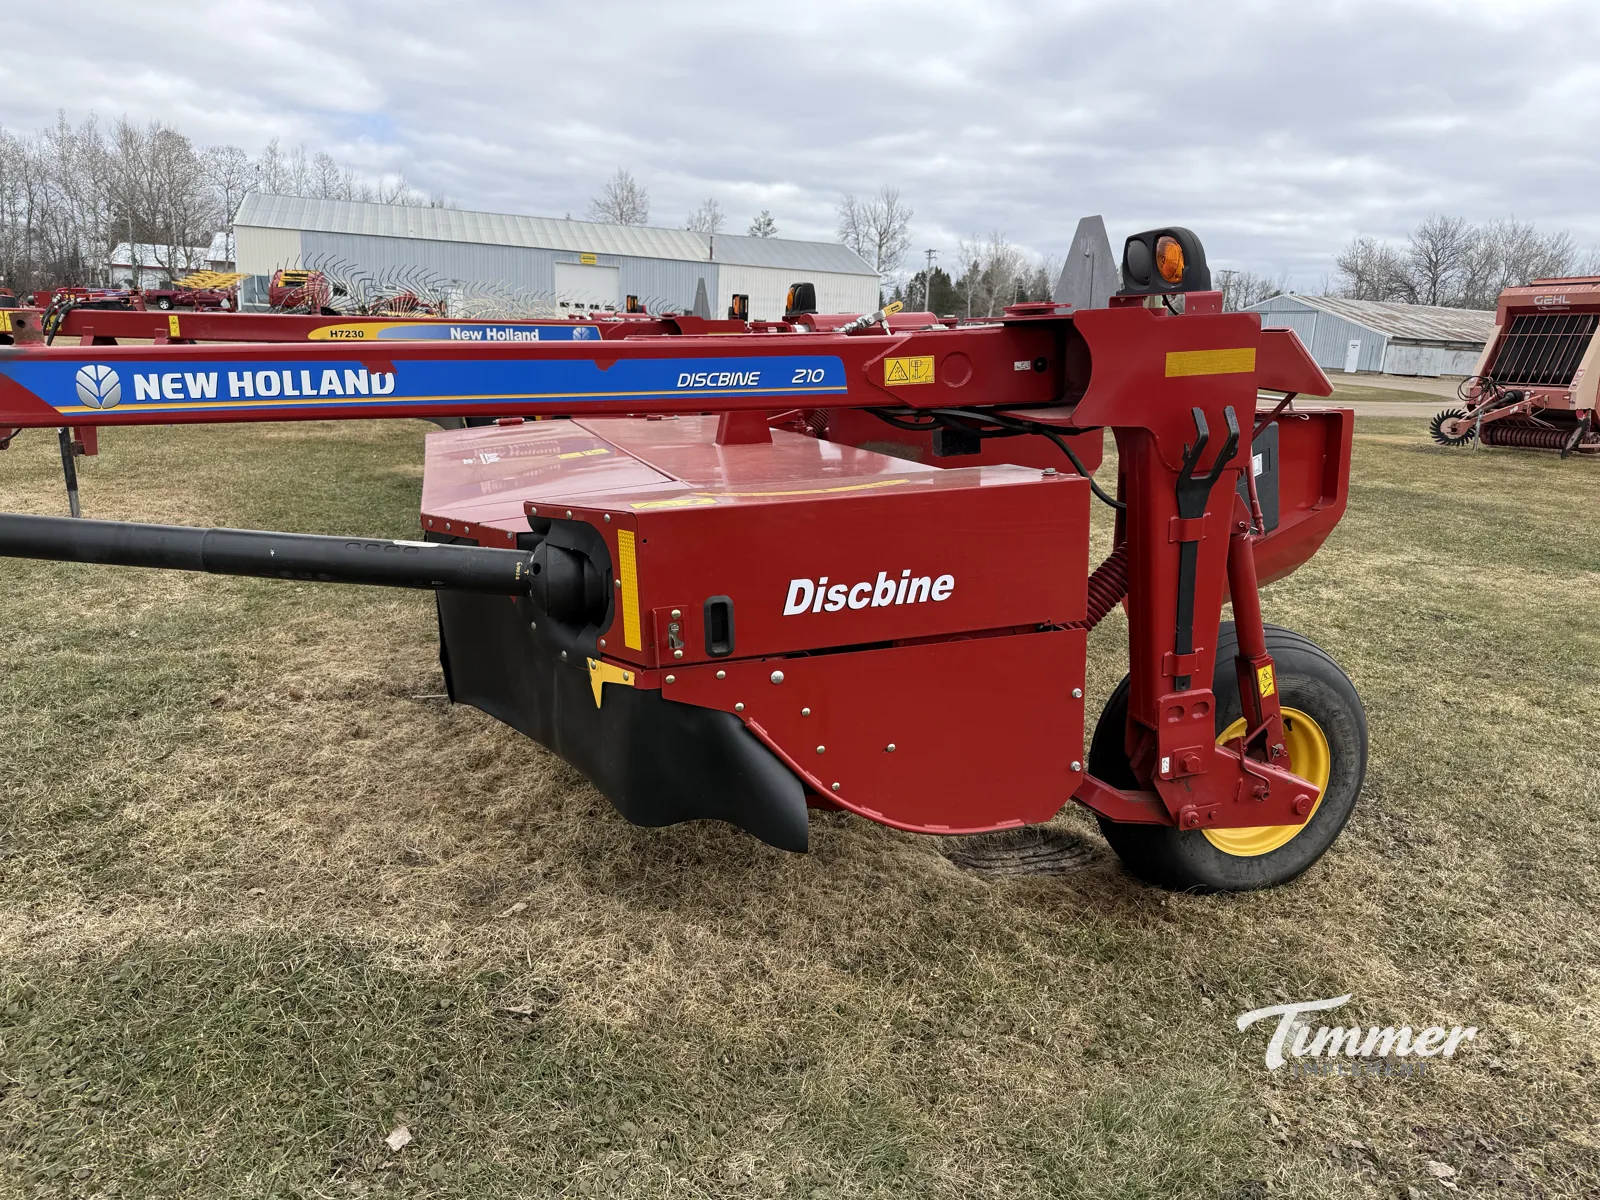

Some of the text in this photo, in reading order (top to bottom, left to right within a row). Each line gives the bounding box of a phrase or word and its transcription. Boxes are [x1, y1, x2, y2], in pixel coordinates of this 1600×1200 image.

[1534, 294, 1571, 305] GEHL
[329, 329, 365, 339] H7230
[450, 327, 540, 341] New Holland
[133, 368, 396, 401] NEW HOLLAND
[676, 368, 826, 389] DISCBINE 210
[782, 568, 956, 617] Discbine
